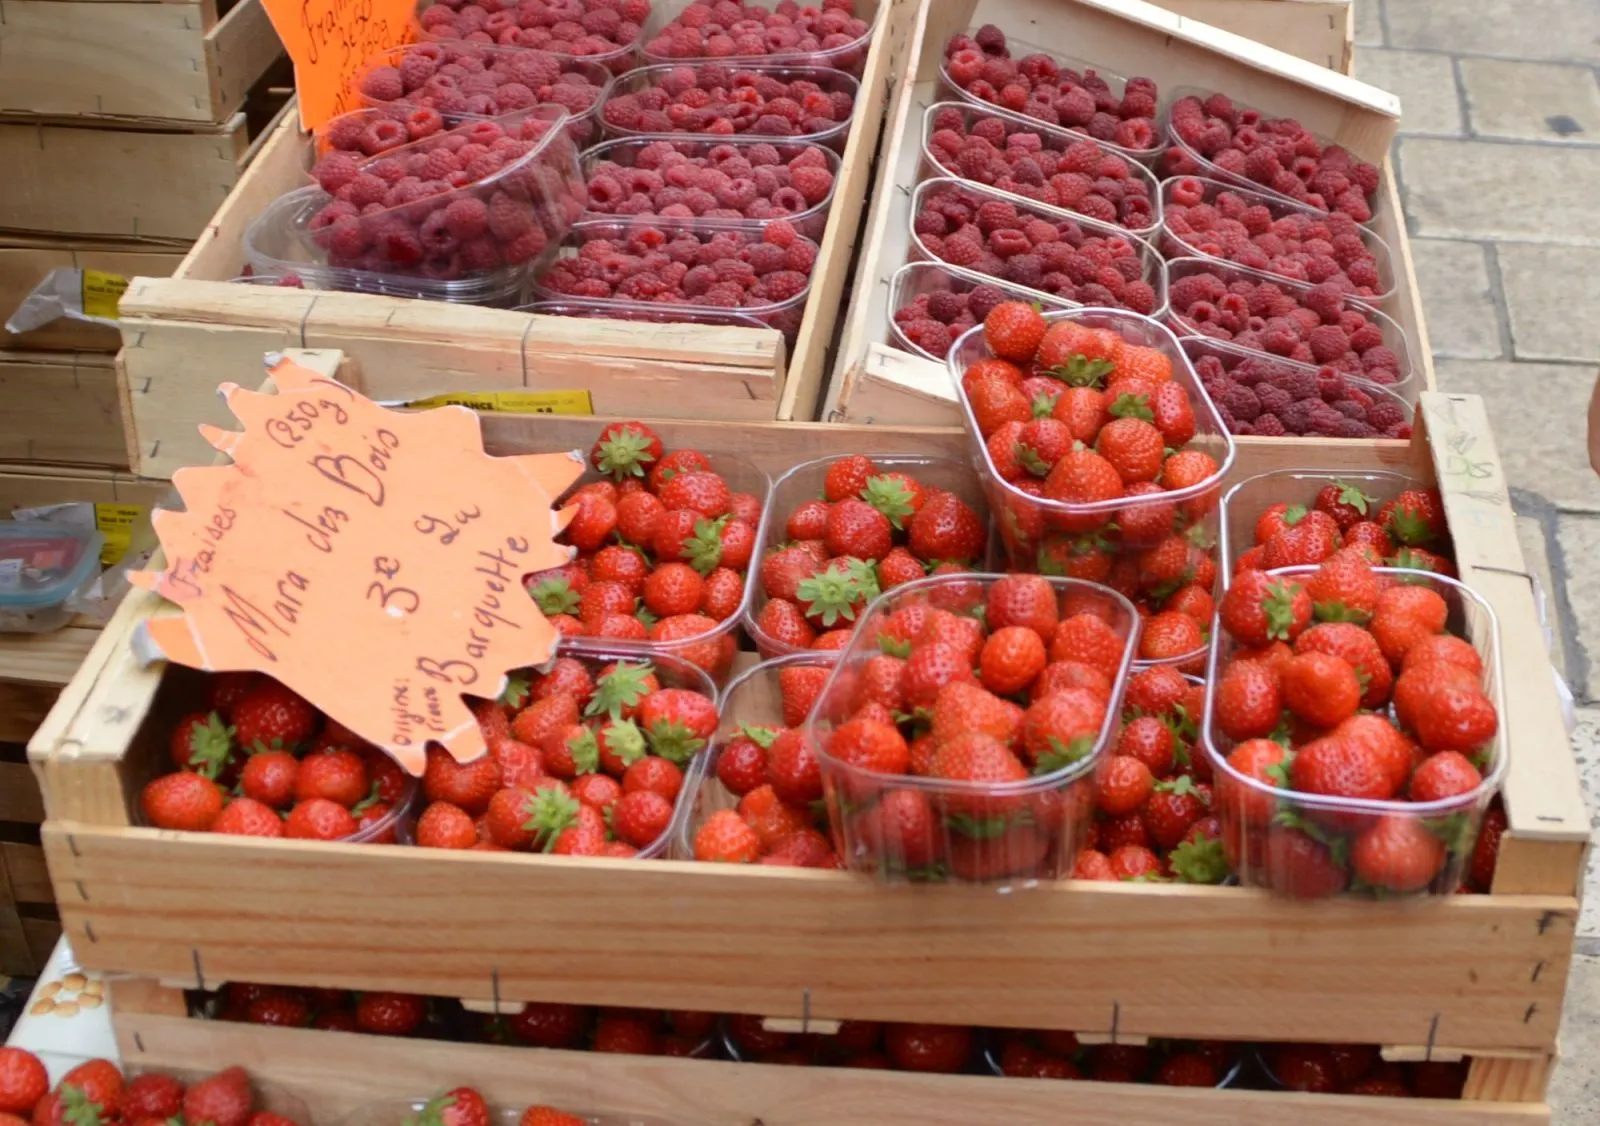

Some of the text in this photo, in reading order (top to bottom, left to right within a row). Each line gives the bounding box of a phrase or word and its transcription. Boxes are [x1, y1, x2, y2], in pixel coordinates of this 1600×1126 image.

[265, 378, 355, 449] (250g)
[167, 505, 238, 598] Fraises
[220, 568, 311, 662] Mara
[307, 425, 401, 507] Bois
[367, 555, 420, 614] 3€
[415, 534, 529, 686] Barquette
